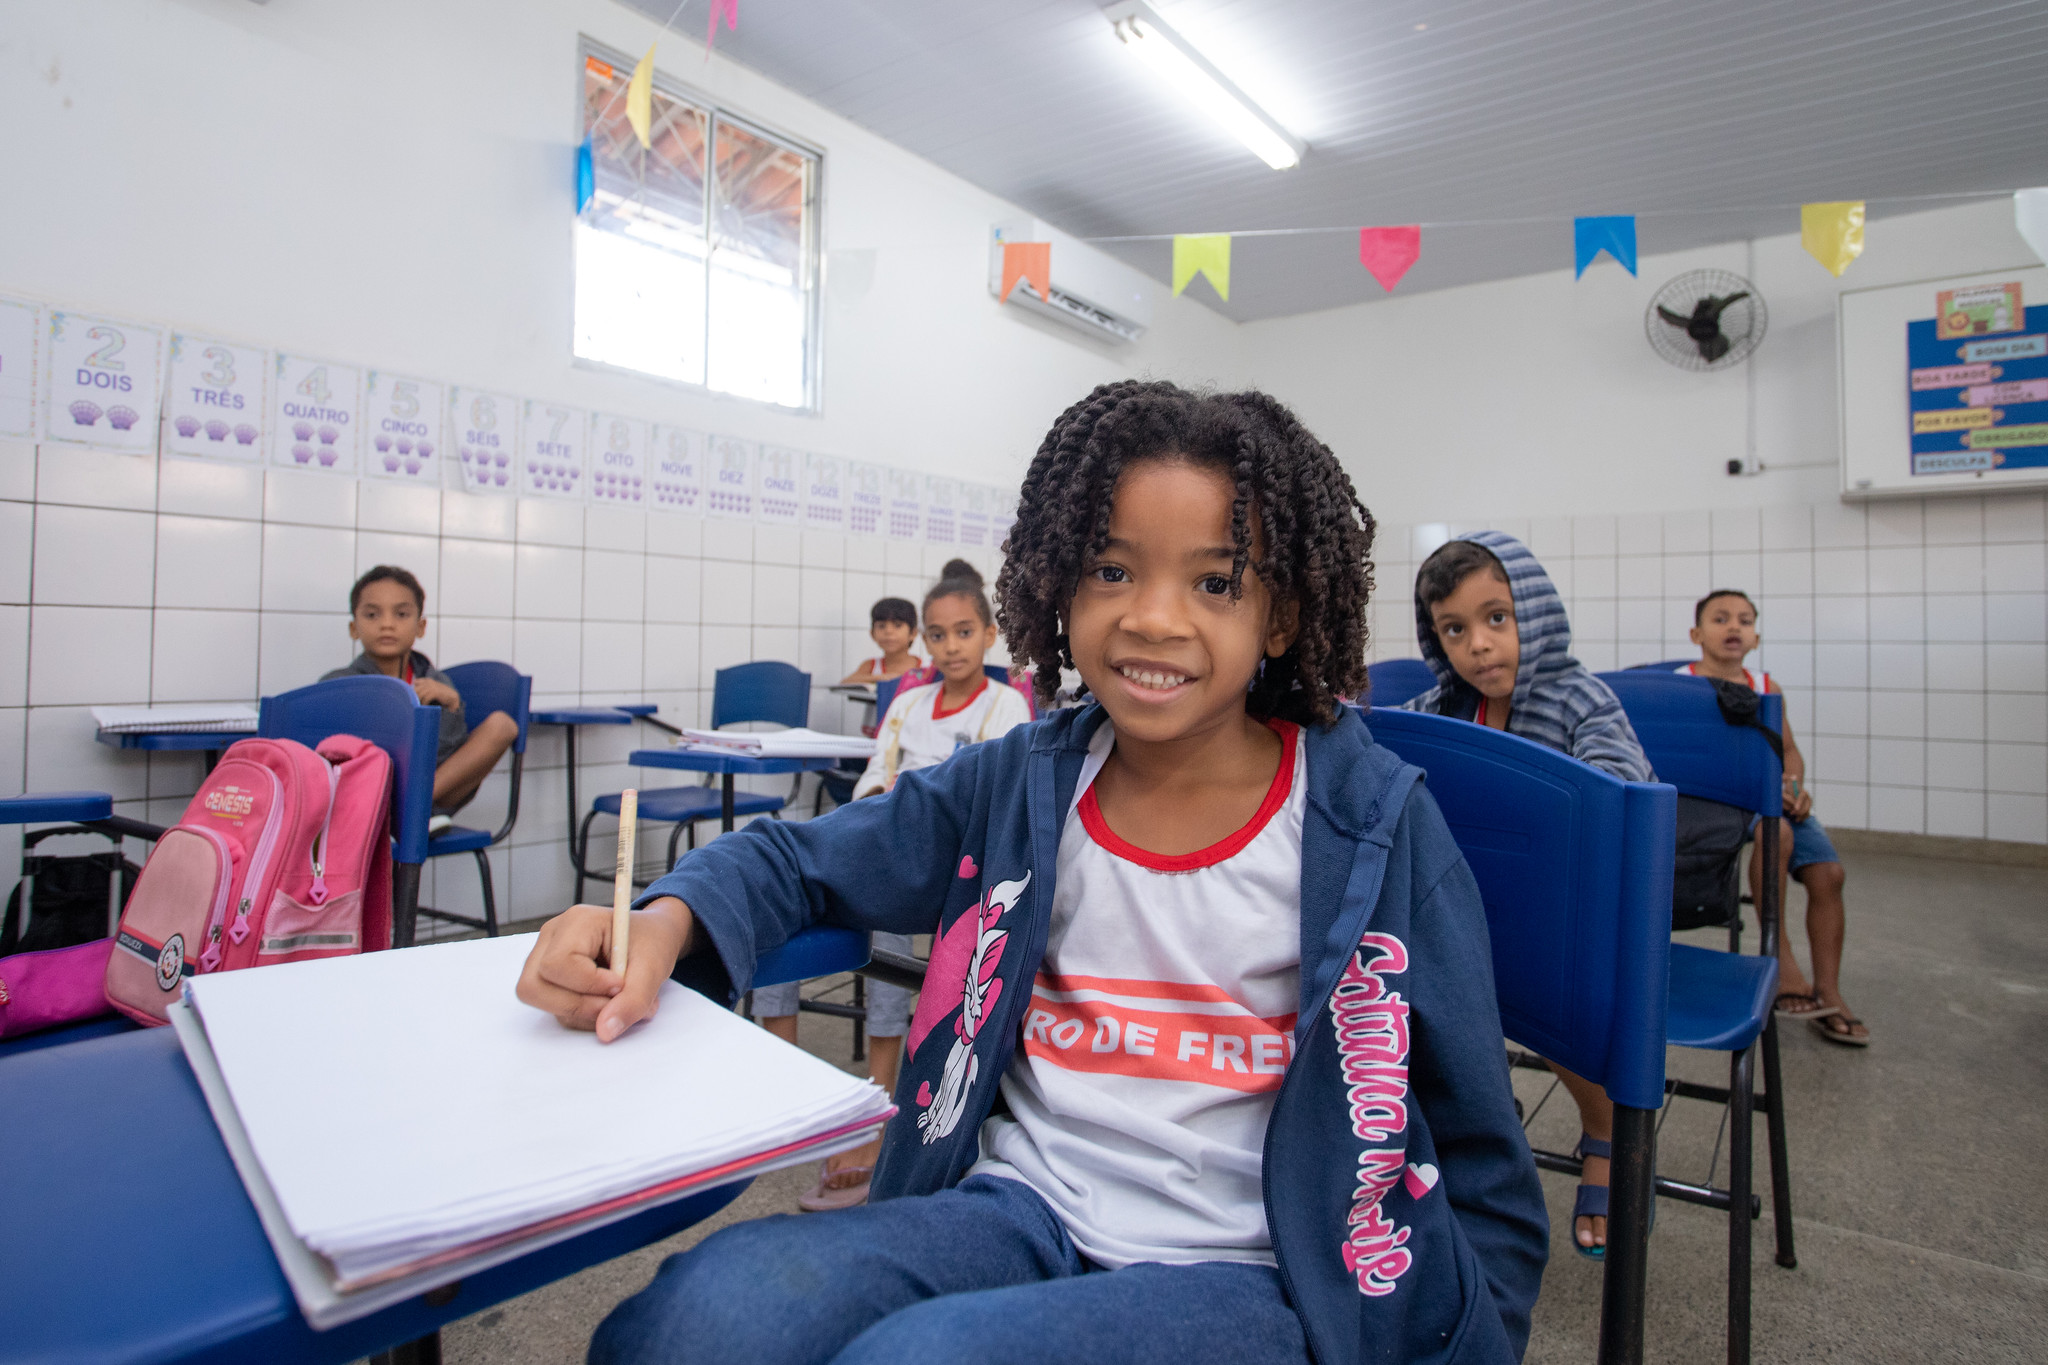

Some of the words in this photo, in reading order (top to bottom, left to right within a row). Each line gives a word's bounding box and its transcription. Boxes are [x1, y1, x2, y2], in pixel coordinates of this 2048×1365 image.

[84, 326, 126, 371] 2
[1975, 344, 2007, 356] BOM
[2011, 342, 2035, 353] DIA
[202, 347, 236, 388] 3
[1913, 373, 1941, 384] BOA
[1946, 370, 1988, 381] TARDE
[76, 368, 133, 392] DOIS
[297, 366, 332, 405] 4
[191, 386, 245, 410] TRÊS
[390, 381, 420, 419] 5
[283, 402, 350, 425] QUATRO
[470, 395, 498, 430] 6
[546, 407, 571, 441] 7
[1915, 417, 1941, 427] POR
[1946, 412, 1988, 423] FAVOR
[381, 418, 428, 437] CINCO
[466, 429, 500, 447] SEIS
[609, 420, 631, 452] 8
[537, 440, 572, 458] SETE
[668, 430, 689, 462] 9
[603, 451, 634, 467] OITO
[661, 461, 693, 477] NOVE
[1921, 456, 1987, 469] DESCULPA
[719, 469, 744, 485] DEZ
[764, 477, 795, 493] ONZE
[205, 792, 254, 815] GENESIS
[1021, 1007, 1085, 1050] RO
[1091, 1015, 1159, 1056] DE
[1347, 1148, 1413, 1297] Marie
